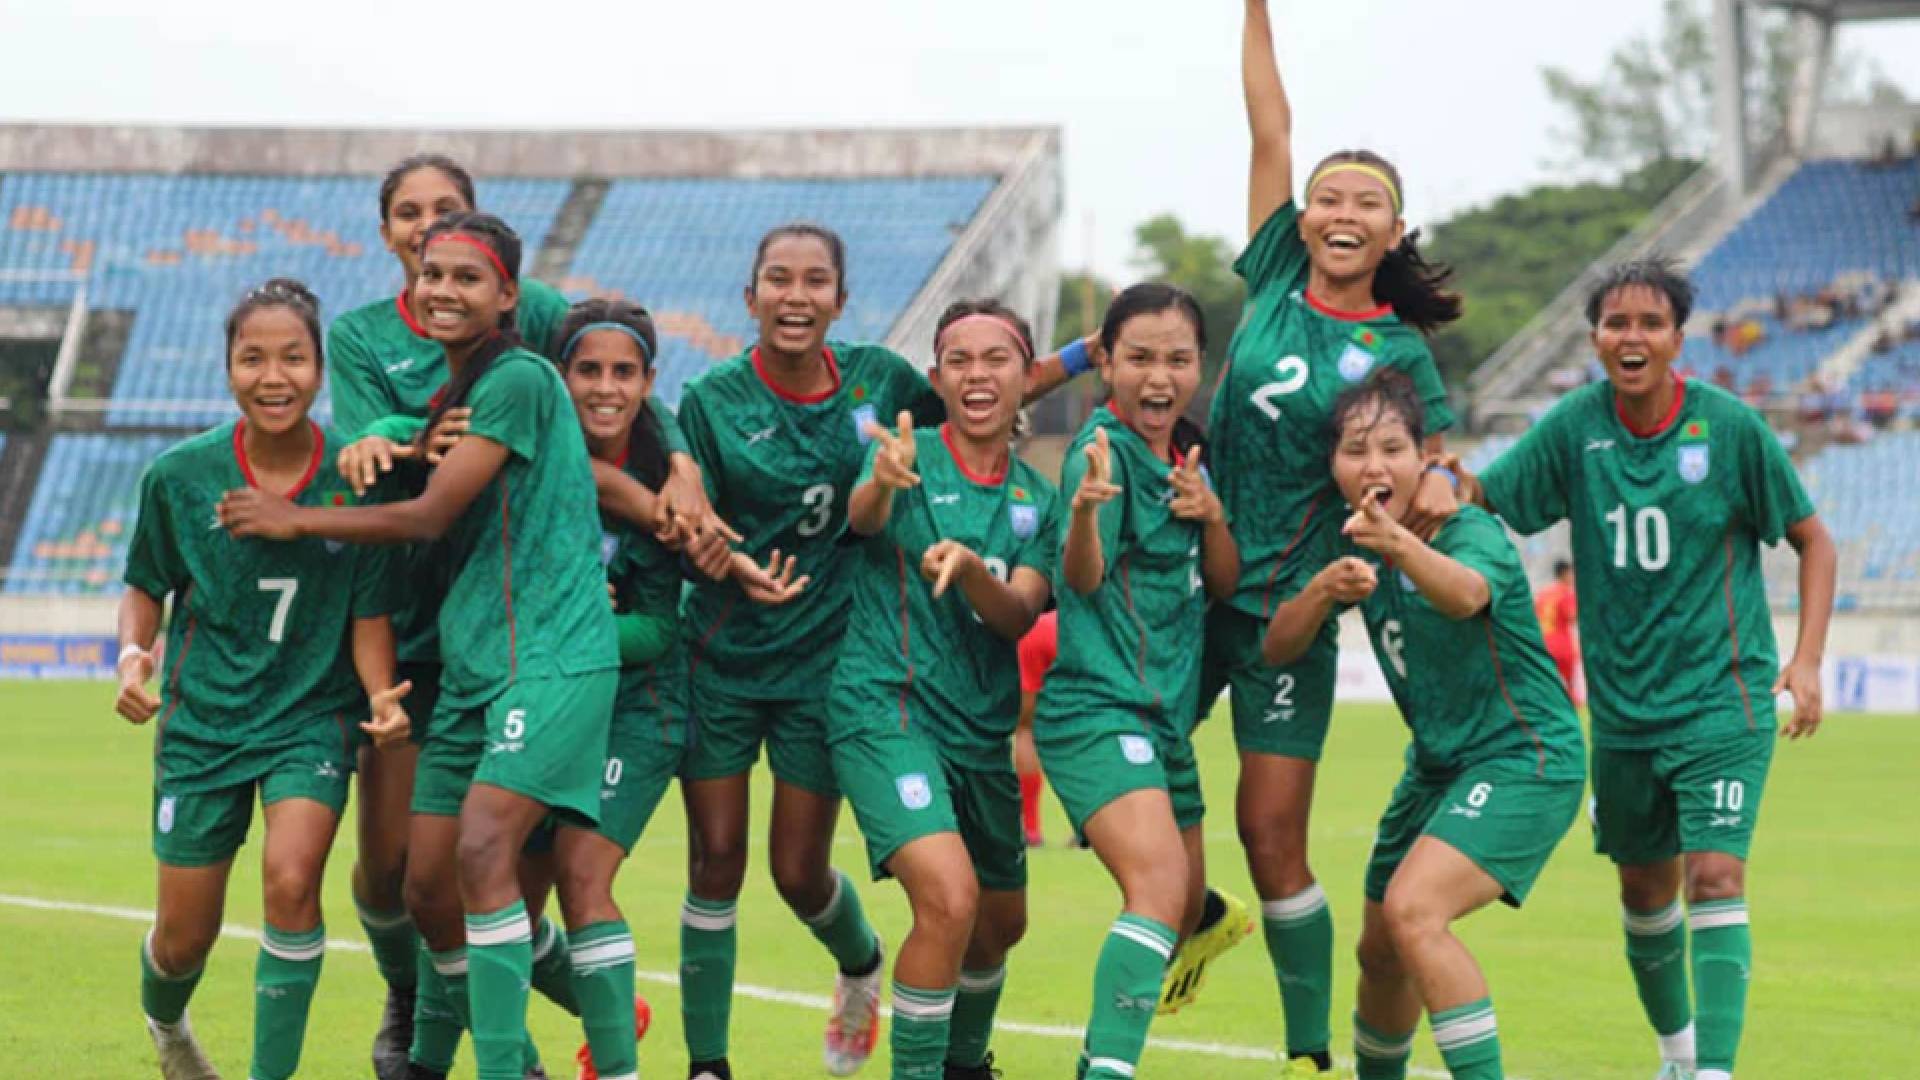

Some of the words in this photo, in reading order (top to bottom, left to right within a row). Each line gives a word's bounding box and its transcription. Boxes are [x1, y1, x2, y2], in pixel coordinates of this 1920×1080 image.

[1249, 354, 1308, 421] 2
[798, 484, 834, 536] 3
[1605, 503, 1670, 571] 10
[257, 578, 298, 642] 7
[1274, 674, 1295, 705] 2
[504, 709, 527, 739] 5
[1467, 782, 1492, 807] 6
[1711, 779, 1744, 811] 10
